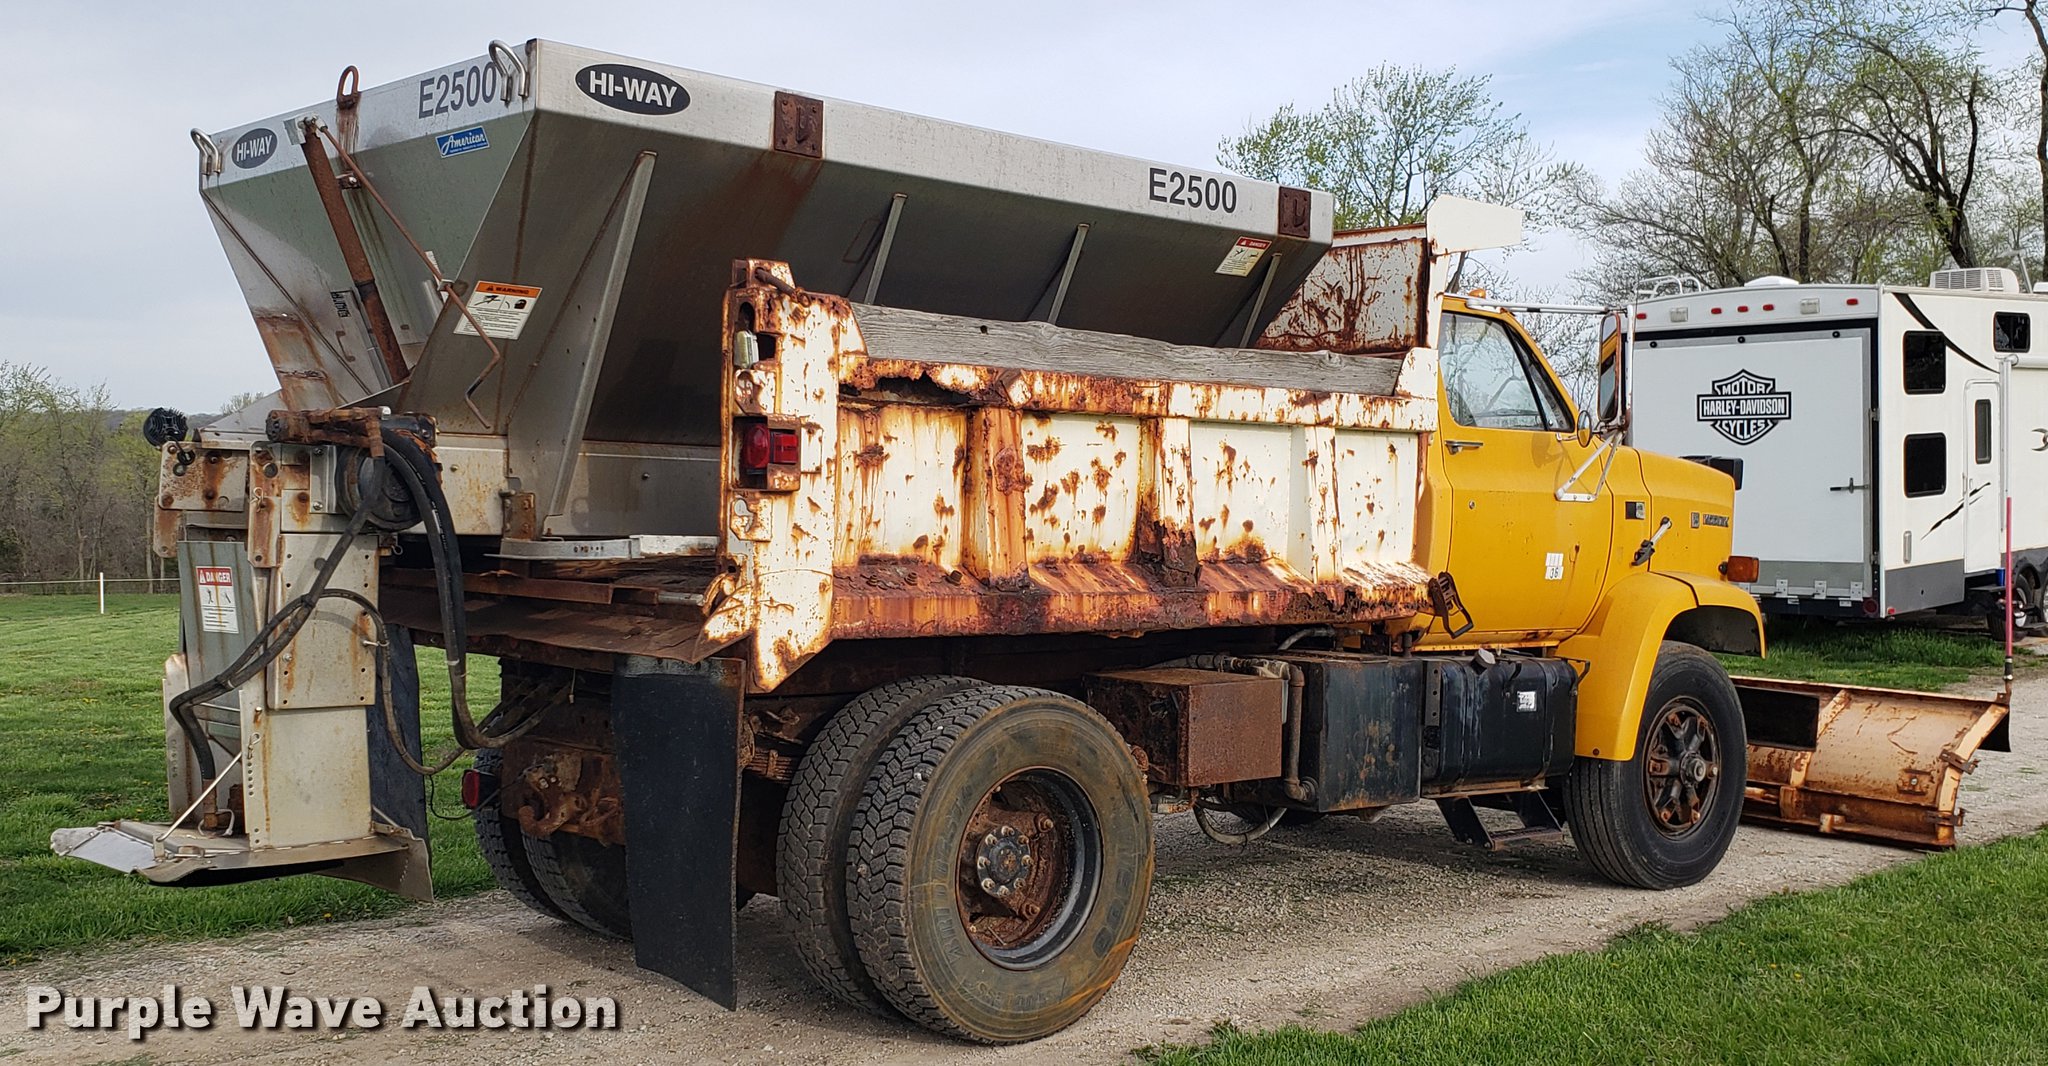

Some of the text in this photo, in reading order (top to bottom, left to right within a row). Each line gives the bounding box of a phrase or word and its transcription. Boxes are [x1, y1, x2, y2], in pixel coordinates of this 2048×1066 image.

[419, 61, 497, 119] E2500
[589, 70, 677, 107] HI-WAY
[236, 134, 272, 162] HI-WAY
[441, 132, 485, 155] American
[1149, 167, 1237, 214] E2500
[496, 287, 529, 295] WARNING
[1722, 377, 1765, 395] MOTOR
[1703, 398, 1785, 416] HARLEY-DAVIDSON
[1722, 419, 1765, 440] CYCLES
[205, 571, 231, 583] DANGER
